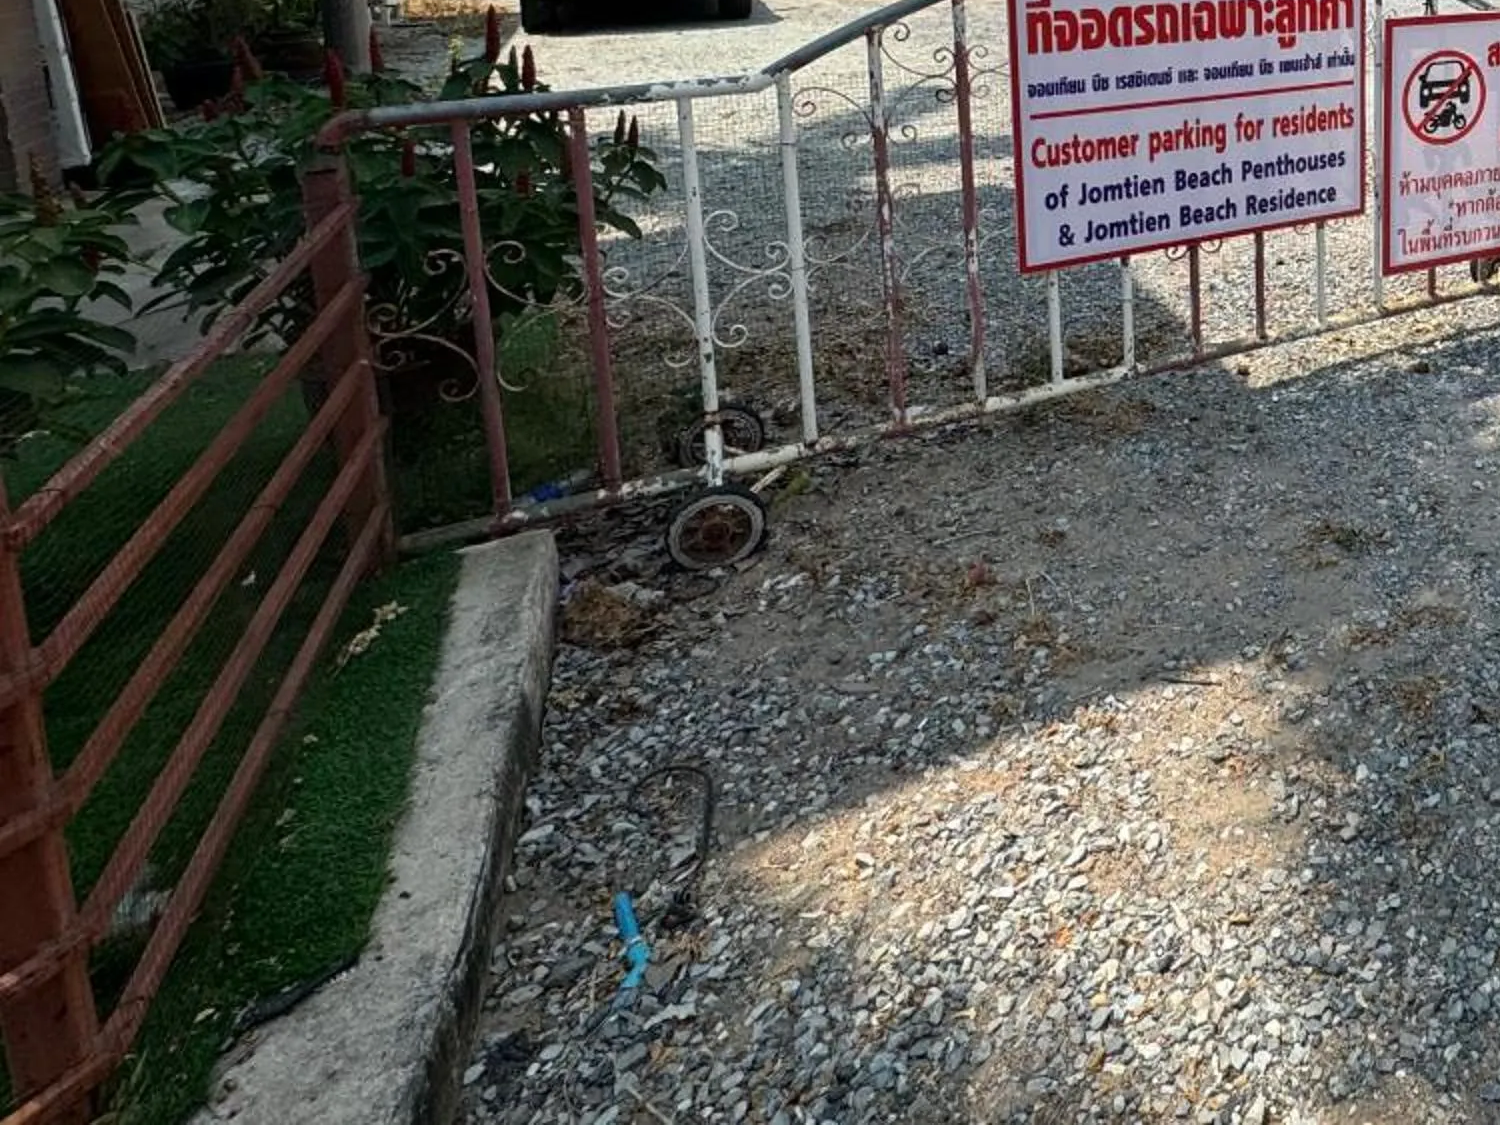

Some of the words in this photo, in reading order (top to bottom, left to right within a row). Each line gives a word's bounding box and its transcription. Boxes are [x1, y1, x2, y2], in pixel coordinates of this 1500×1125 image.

[1031, 132, 1138, 169] Customer
[1148, 118, 1226, 161] parking
[1235, 112, 1265, 143] for
[1272, 102, 1355, 138] residents
[1044, 184, 1069, 212] of
[1078, 174, 1165, 207] Jomtien
[1175, 163, 1232, 191] Beach
[1241, 148, 1346, 181] Penthouses
[1058, 223, 1075, 248] &
[1084, 211, 1170, 244] Jomtien
[1180, 198, 1237, 227] Beach
[1246, 184, 1337, 216] Residence
